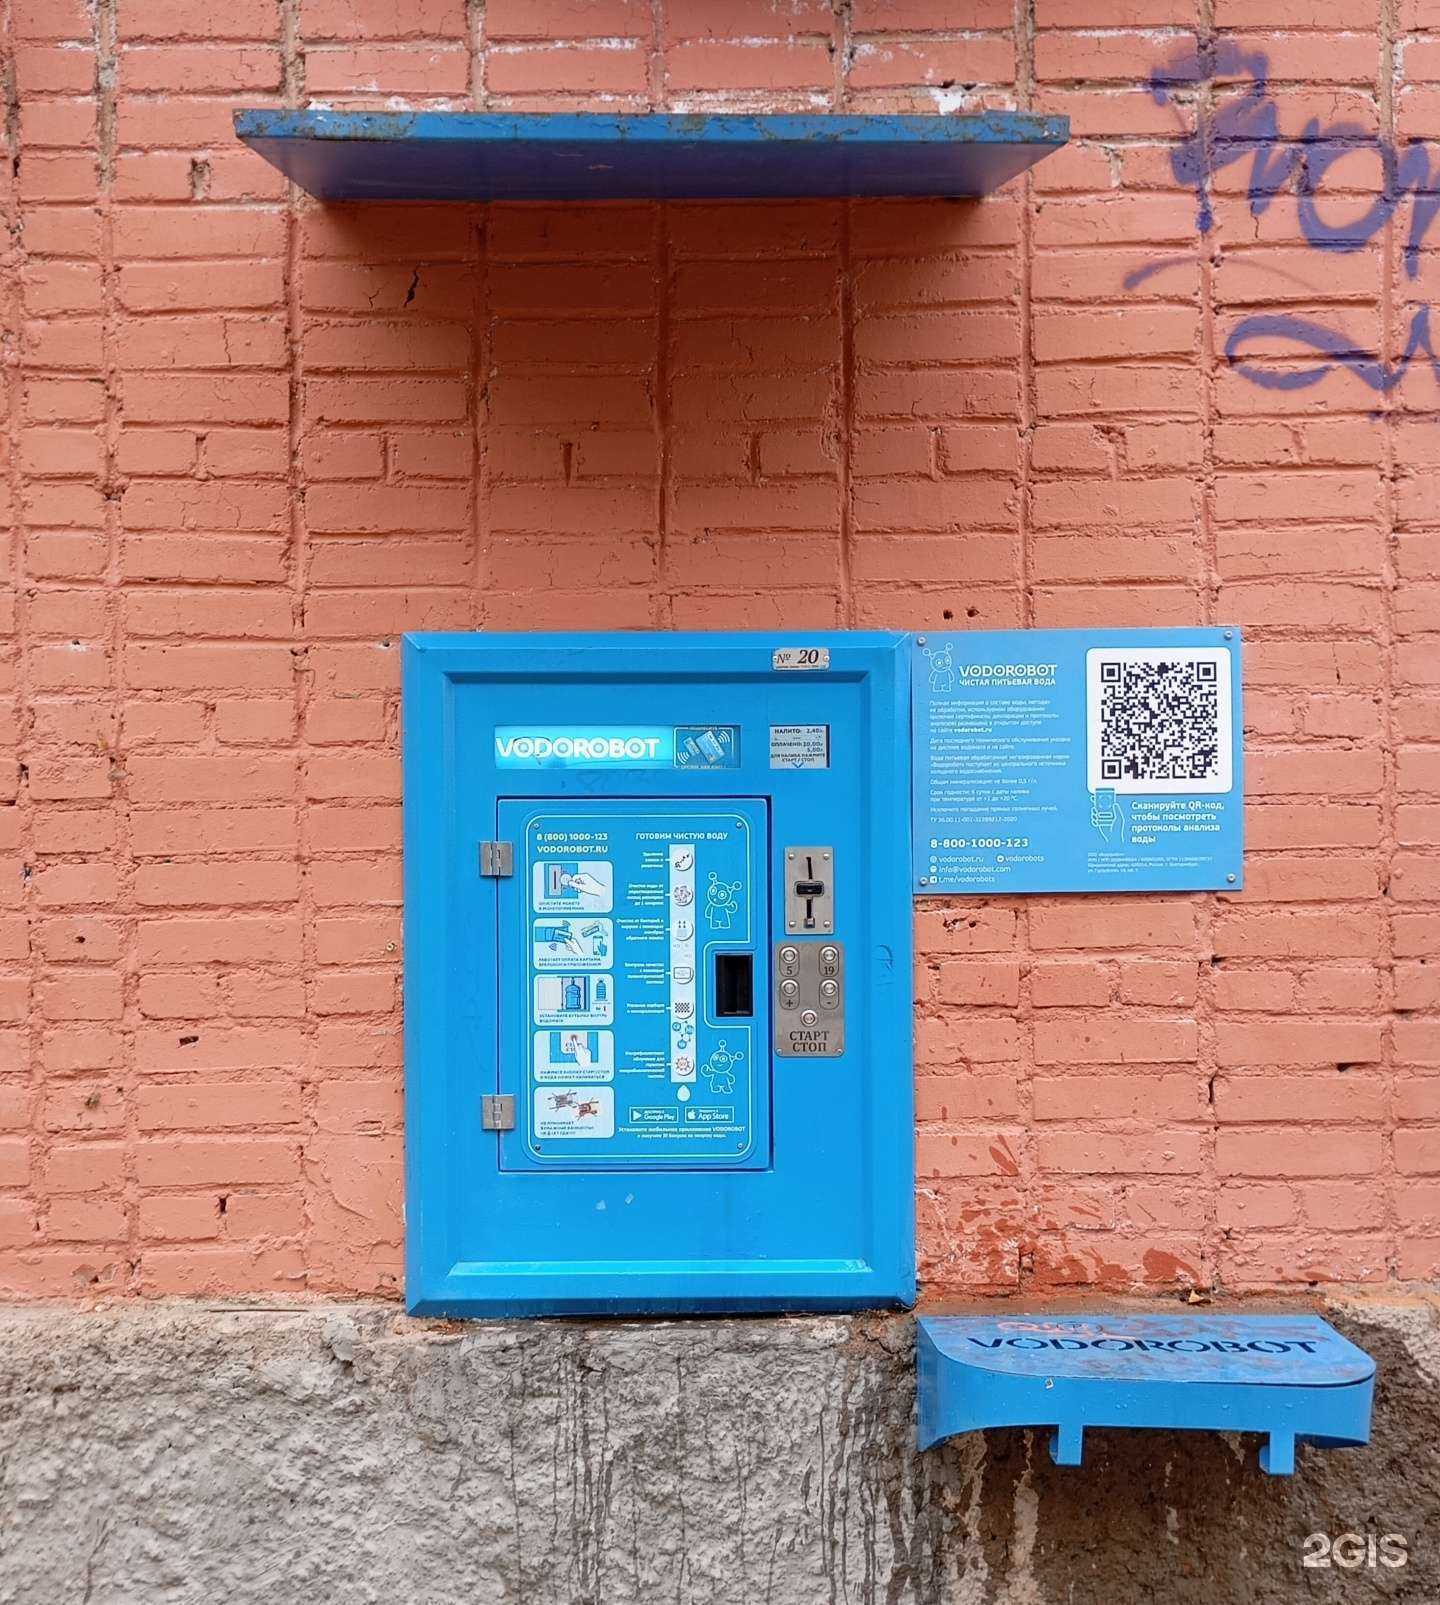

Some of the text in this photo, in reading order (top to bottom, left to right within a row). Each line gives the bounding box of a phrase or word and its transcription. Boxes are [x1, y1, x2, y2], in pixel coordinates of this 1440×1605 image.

[797, 649, 819, 665] 20
[959, 664, 1058, 677] VODOROBOT
[959, 677, 1056, 687] ЧИСТАЯ ПИТЬЕВАЯ ВОДА
[496, 737, 660, 759] VODOROBOT
[1131, 800, 1186, 811] Сканируйте
[1131, 813, 1217, 823] чтобы посмотреть
[1131, 825, 1181, 833] протоколы
[536, 832, 608, 841] 8 (800) 1000-123
[635, 832, 728, 840] ГОТОВИМ ЧИСТУЮ ВОДУ
[930, 838, 1029, 848] 8-800-1000-123
[537, 845, 608, 853] VODOROBOT.RU
[938, 855, 984, 863] vodorobot.ru
[938, 865, 1011, 874] info@vodorobot.com
[786, 966, 793, 975] 5
[824, 966, 835, 975] 19
[789, 1031, 830, 1041] СТАРТ
[792, 1042, 827, 1053] СТОП
[643, 1112, 675, 1121] Google Play
[697, 1112, 712, 1121] App
[966, 1336, 1318, 1354] VODOROBOT
